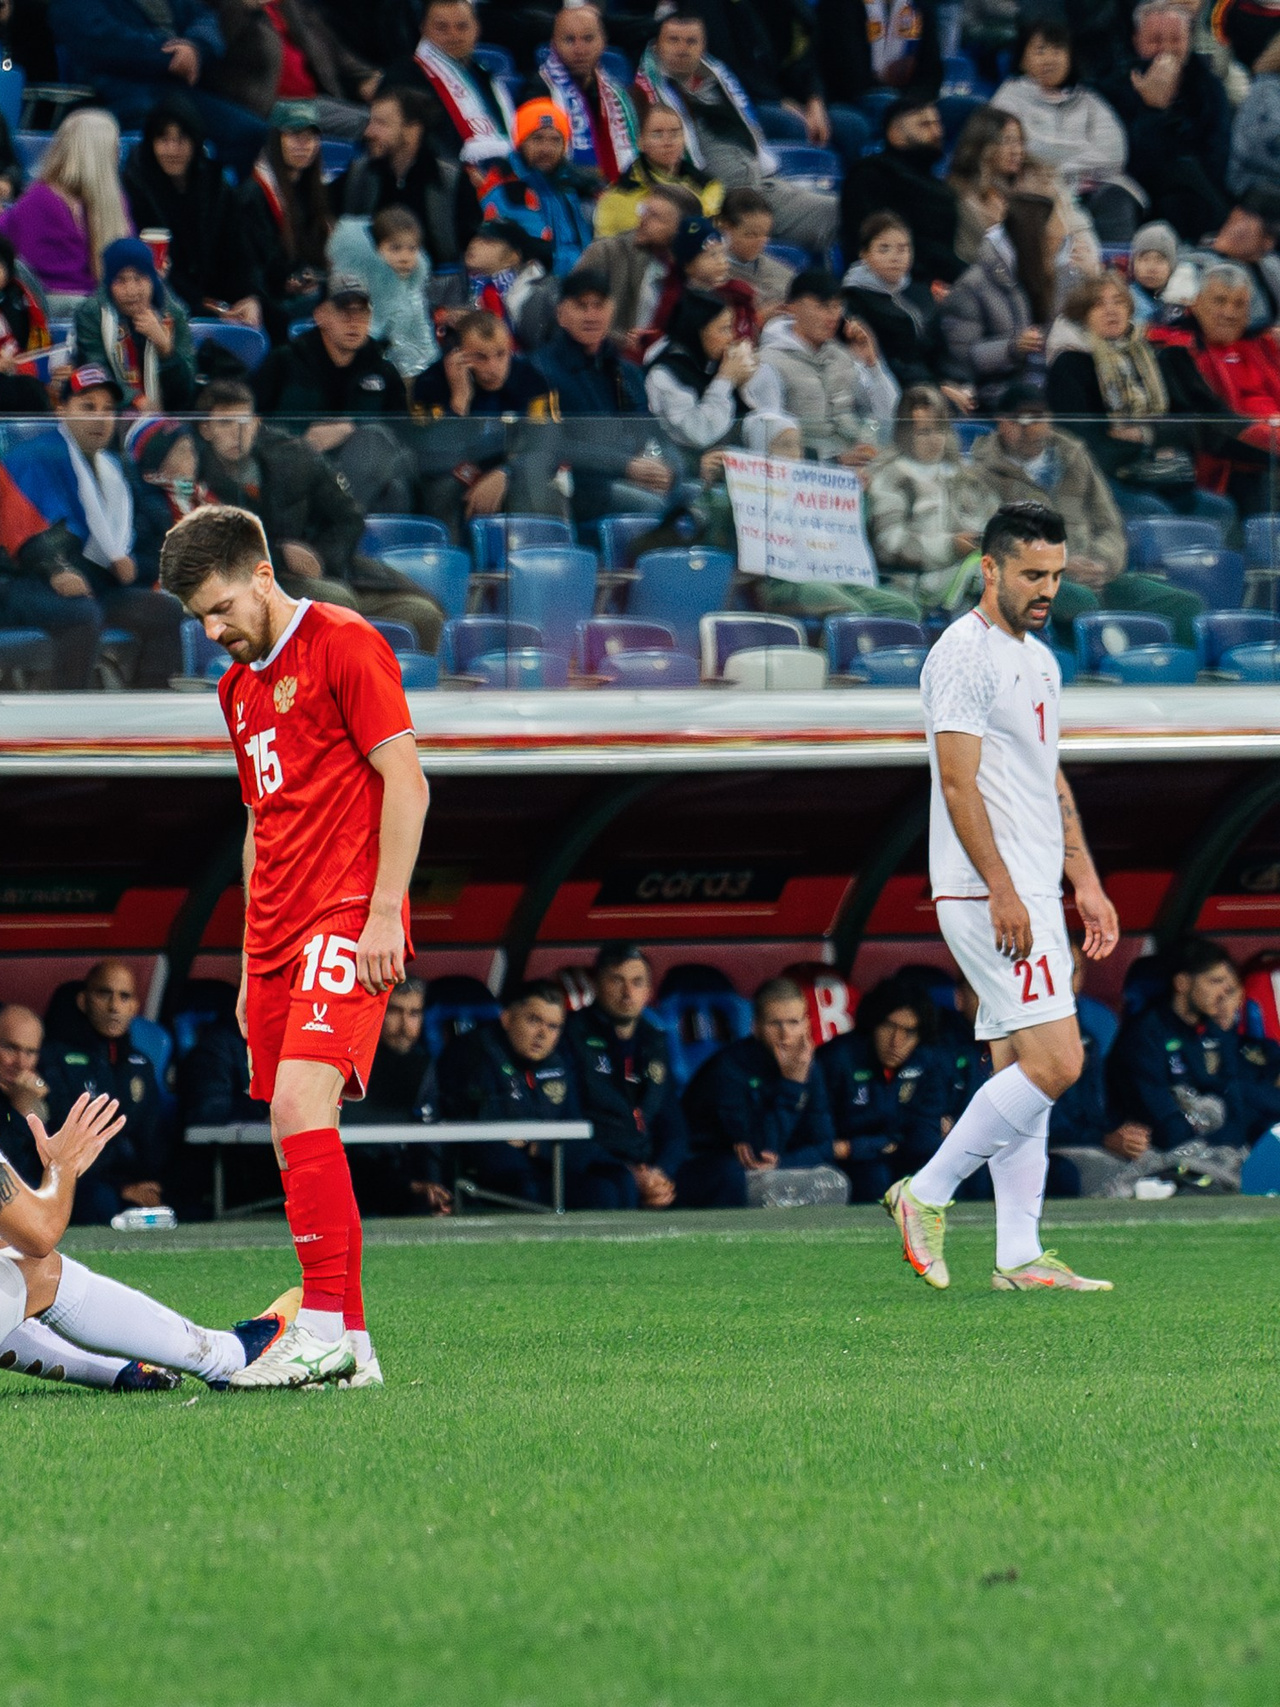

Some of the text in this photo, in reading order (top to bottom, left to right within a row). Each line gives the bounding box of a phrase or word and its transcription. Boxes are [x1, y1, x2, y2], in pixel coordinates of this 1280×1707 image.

[244, 727, 284, 799] 15
[301, 933, 358, 995] 15
[1014, 954, 1055, 1004] 21
